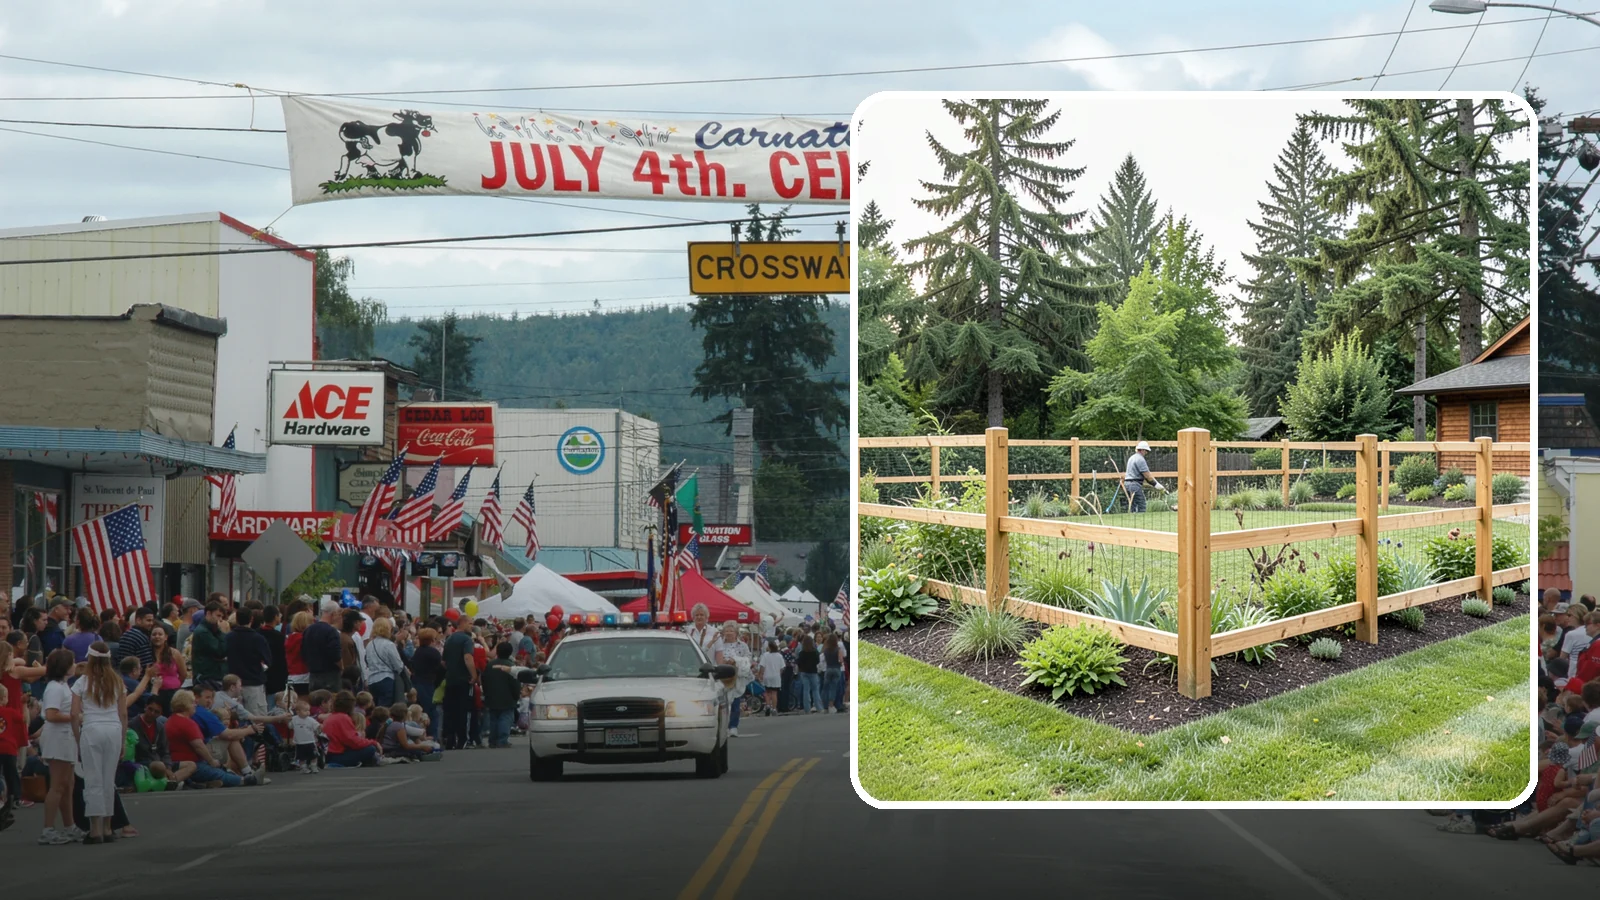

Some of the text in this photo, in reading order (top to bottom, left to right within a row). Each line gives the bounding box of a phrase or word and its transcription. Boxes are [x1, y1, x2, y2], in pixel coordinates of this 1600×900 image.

[481, 141, 605, 193] JULY
[632, 150, 746, 198] 4th.
[697, 254, 850, 280] CROSSWA
[282, 380, 373, 420] ACE
[405, 409, 452, 422] CEDAR
[283, 421, 371, 436] Hardware
[416, 428, 477, 447] Coca-Cola
[353, 467, 386, 481] Simpl
[95, 485, 124, 495] Vincent
[126, 485, 136, 495] de
[137, 485, 155, 495] Paul
[81, 503, 154, 522] THRT
[212, 516, 331, 535] HARDARE
[688, 526, 741, 535] CRNATION
[699, 535, 730, 543] GLASS
